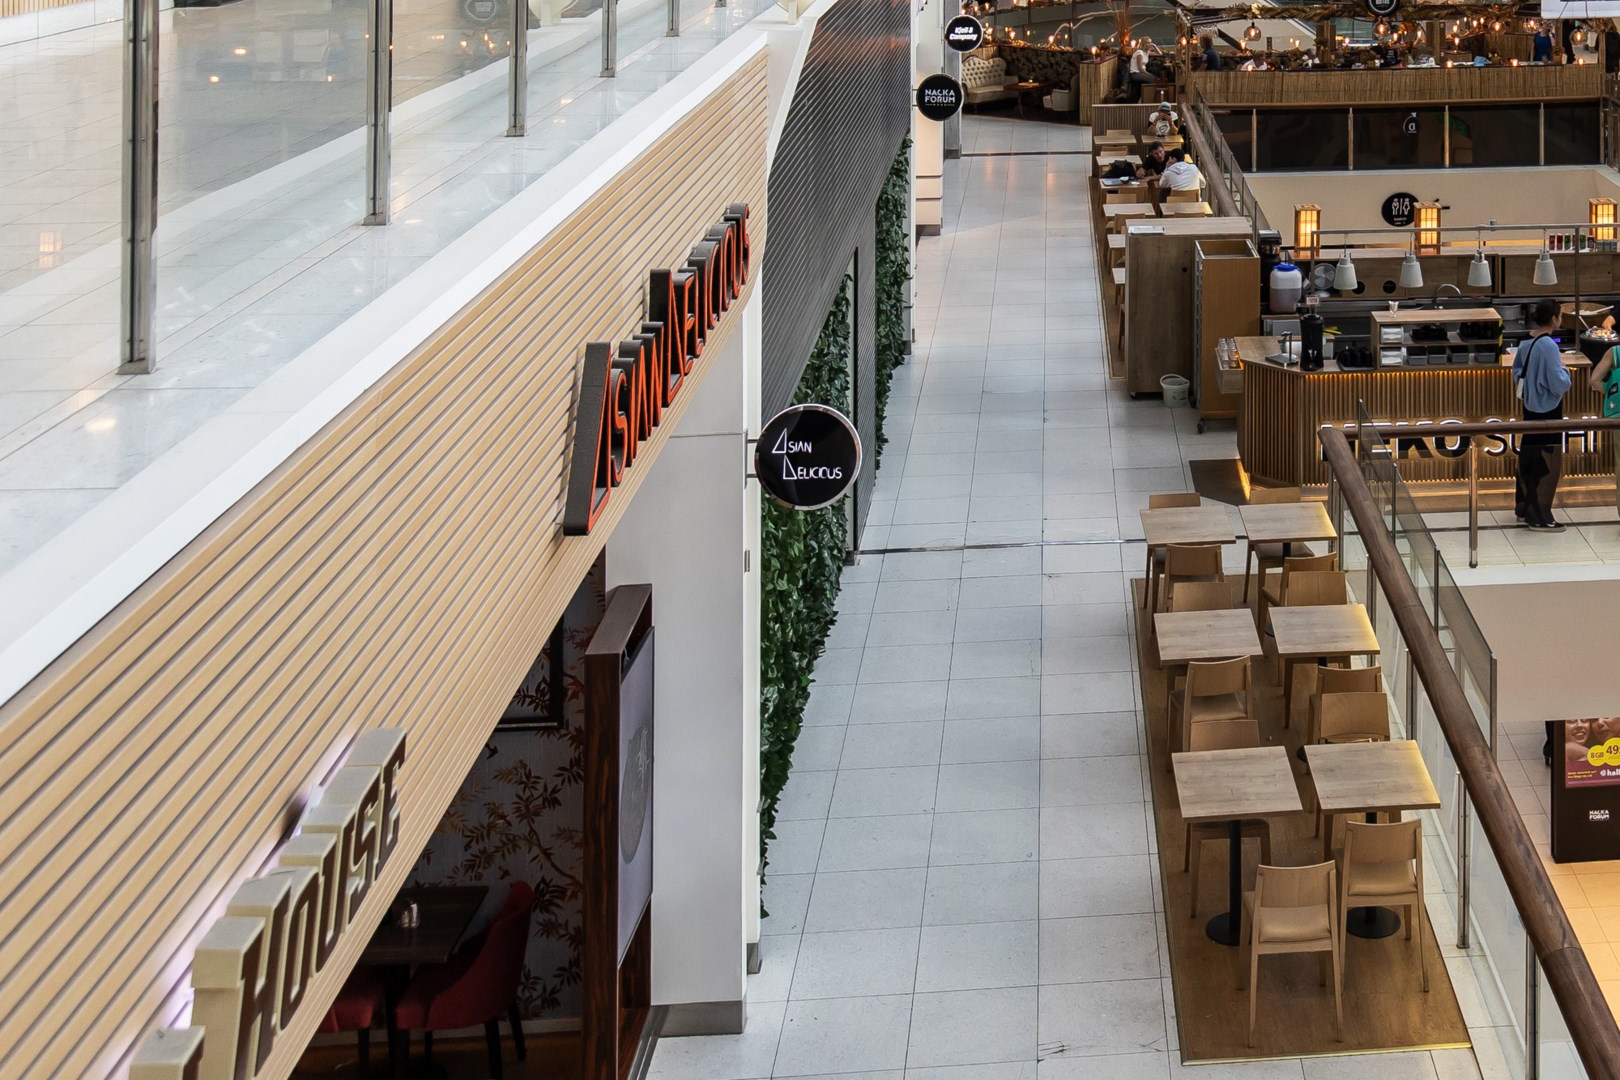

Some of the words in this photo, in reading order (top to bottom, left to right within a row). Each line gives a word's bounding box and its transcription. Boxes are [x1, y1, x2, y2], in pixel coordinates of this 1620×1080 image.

[924, 88, 956, 96] NACKA
[924, 96, 956, 104] FORUM
[771, 427, 812, 454] ASIAN
[783, 454, 843, 480] DELICIOUS
